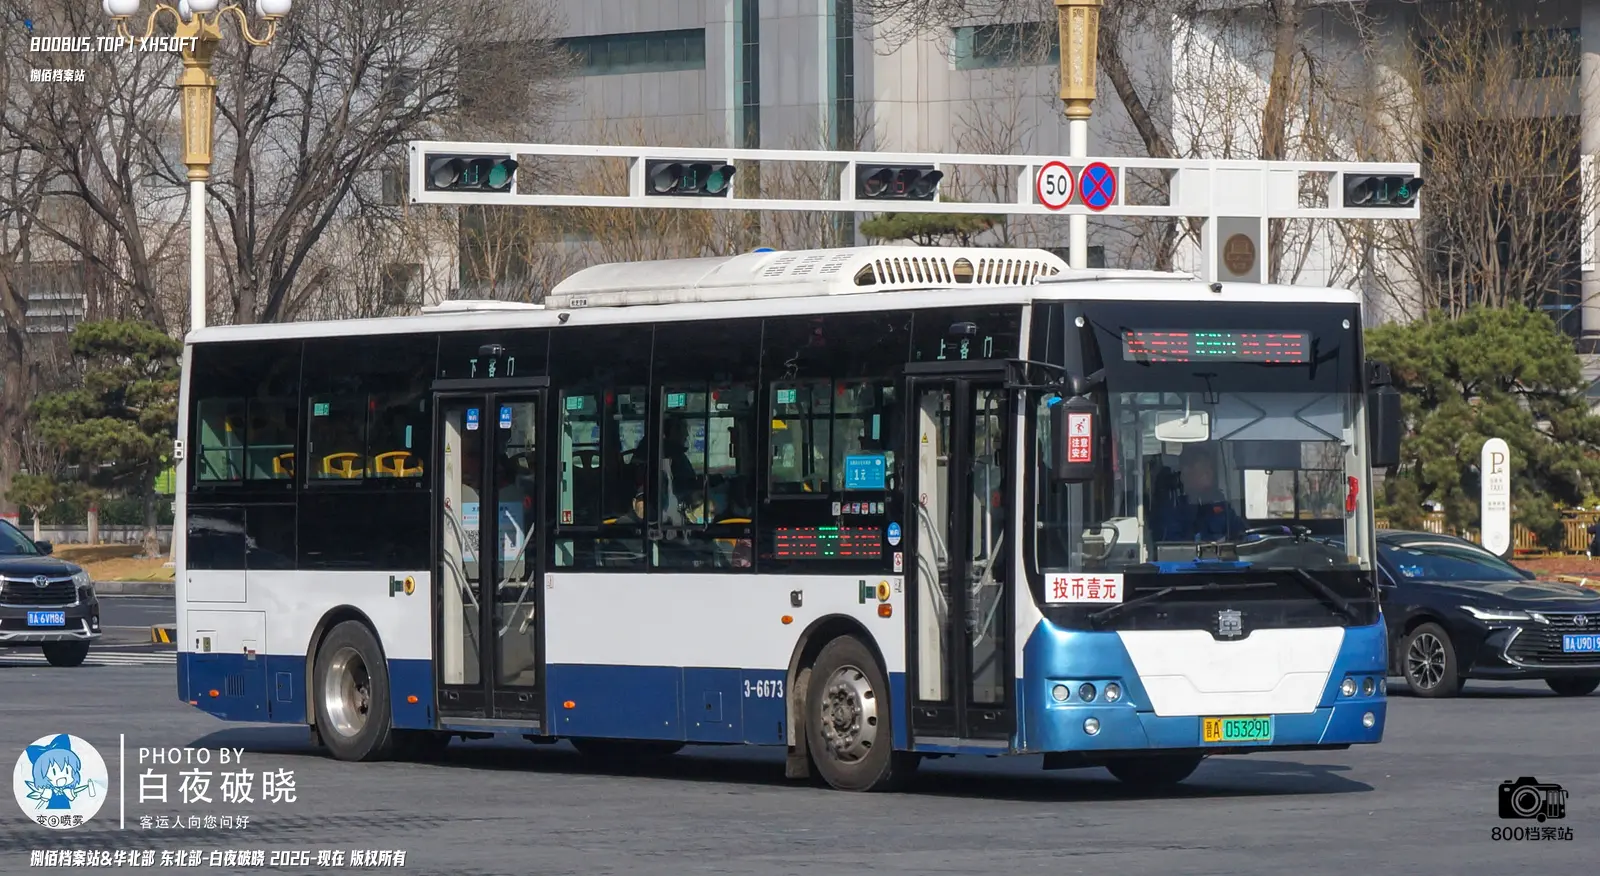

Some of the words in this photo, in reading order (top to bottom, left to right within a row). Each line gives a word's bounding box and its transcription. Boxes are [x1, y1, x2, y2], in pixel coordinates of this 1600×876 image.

[1046, 174, 1067, 195] 50
[1071, 438, 1088, 448] 注意
[1071, 448, 1088, 458] 安全
[1490, 452, 1504, 474] P
[1053, 578, 1117, 600] 投币壹元
[744, 680, 784, 698] 3-6673
